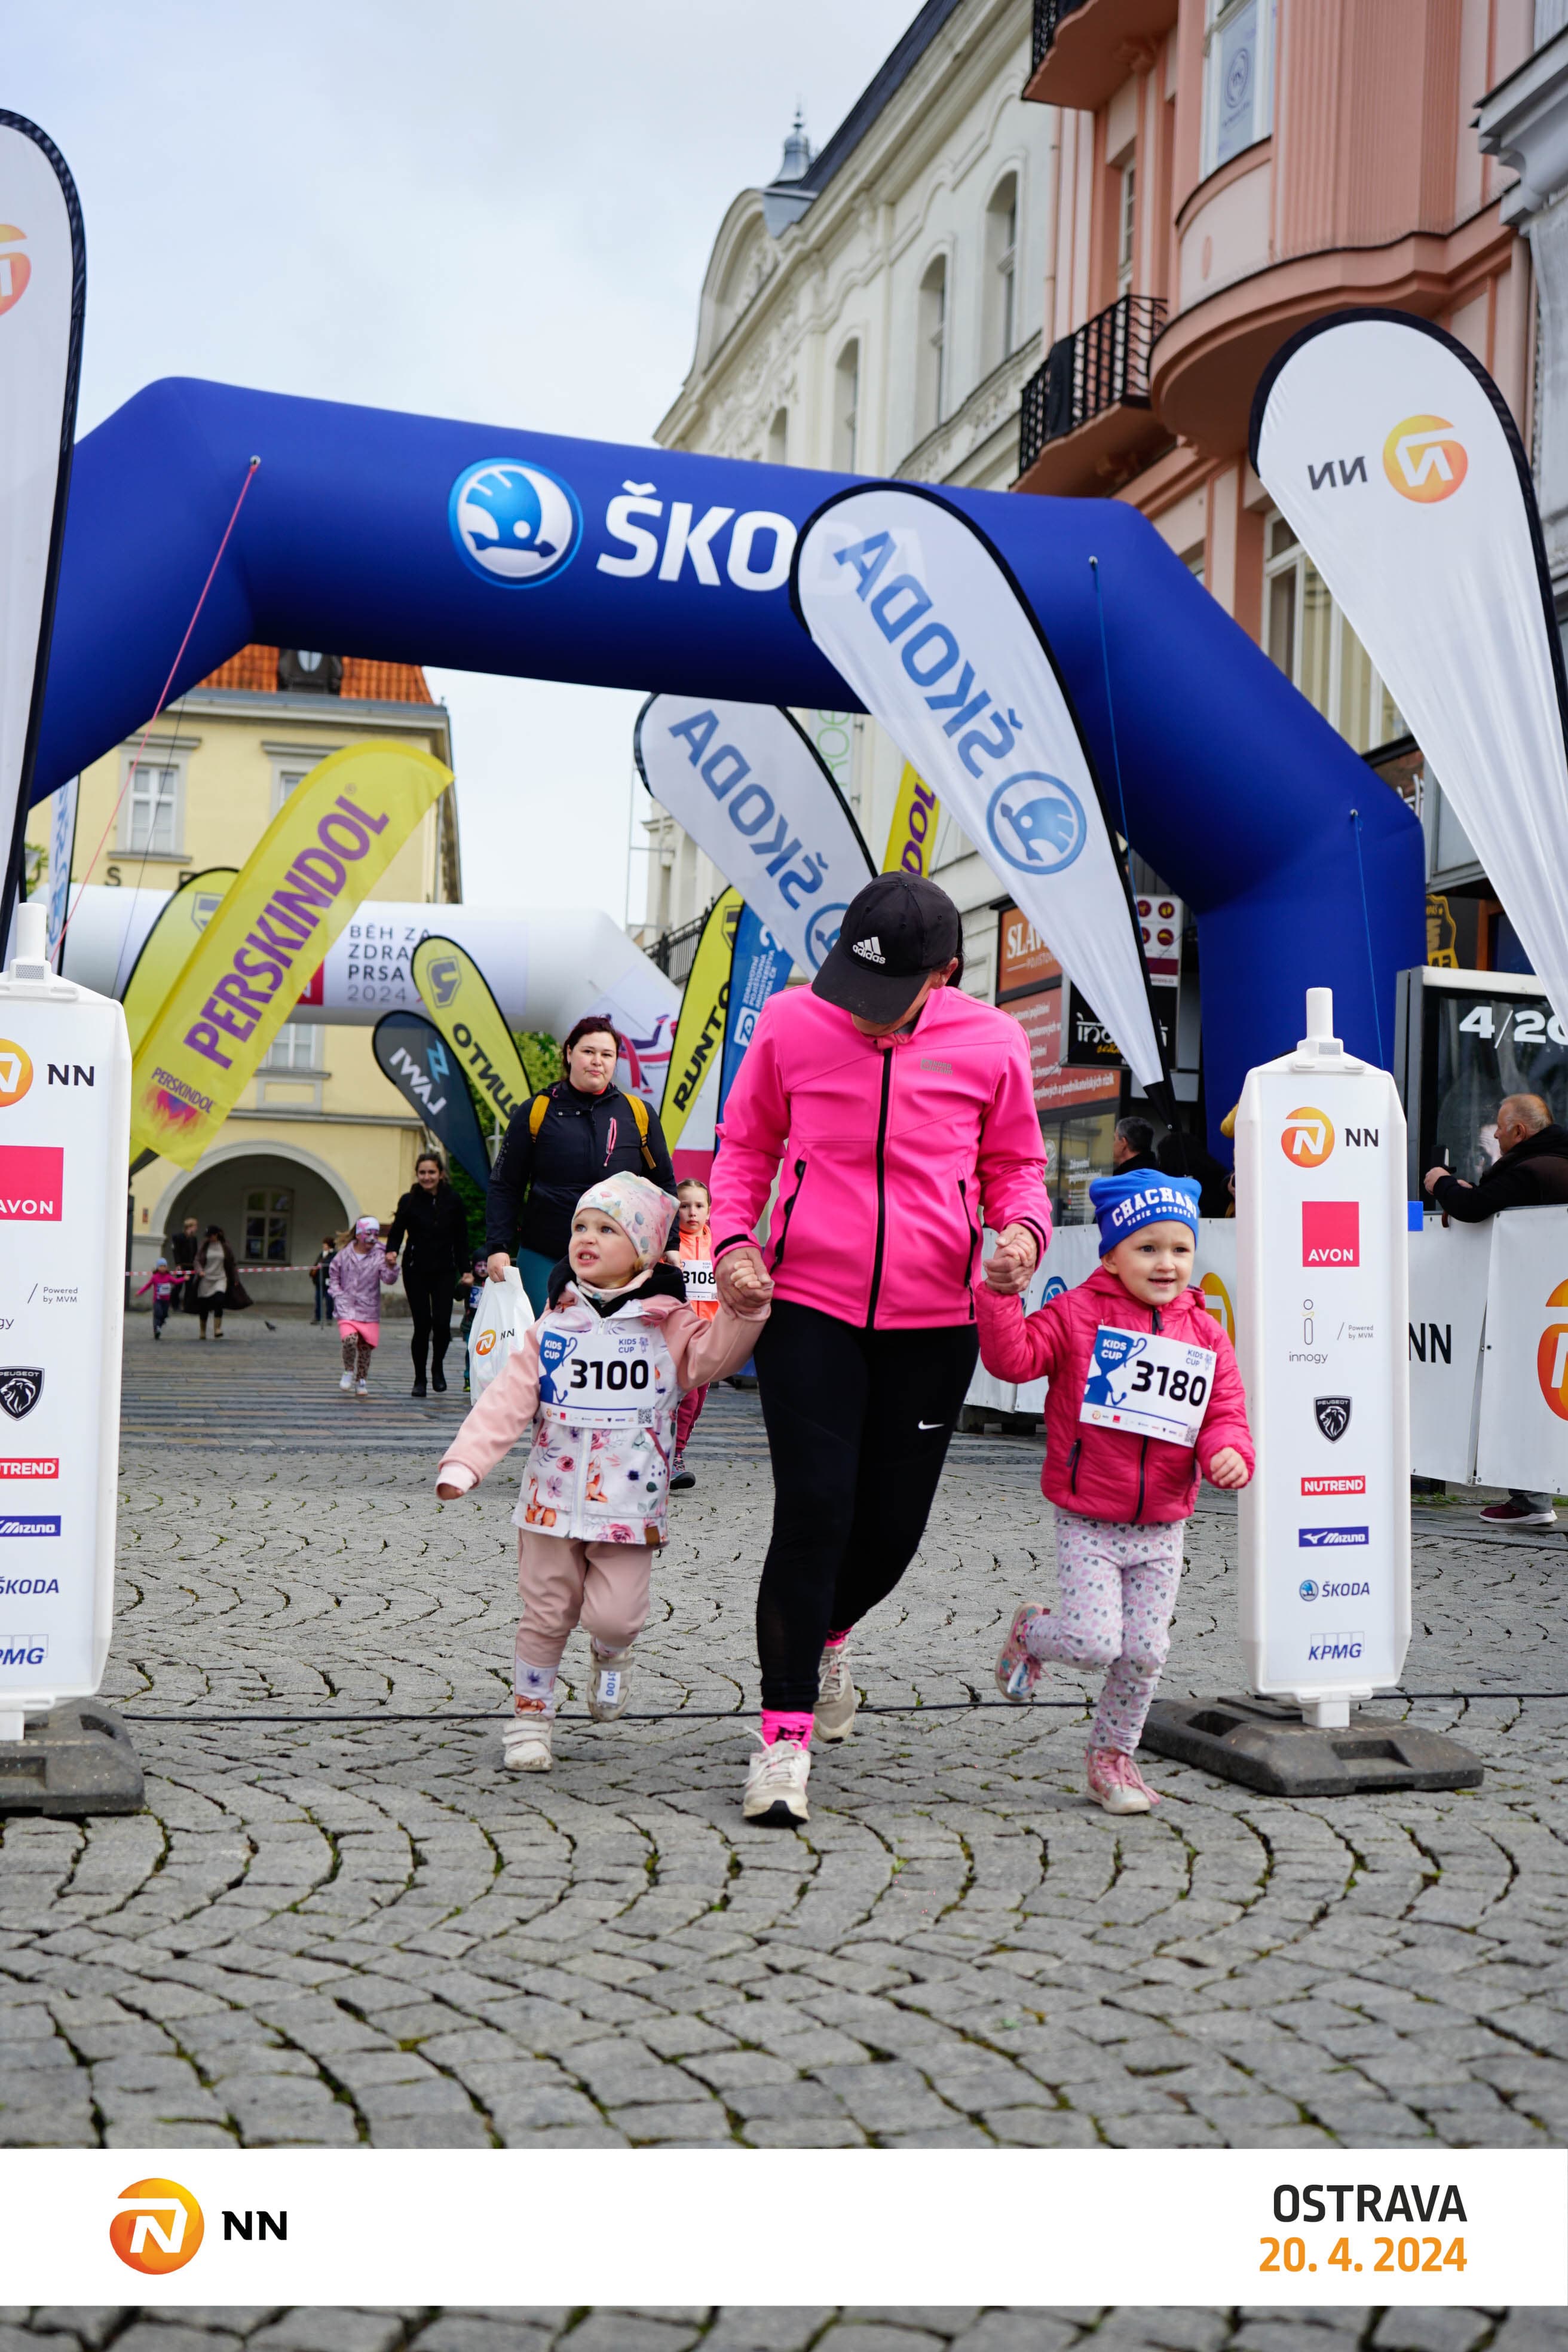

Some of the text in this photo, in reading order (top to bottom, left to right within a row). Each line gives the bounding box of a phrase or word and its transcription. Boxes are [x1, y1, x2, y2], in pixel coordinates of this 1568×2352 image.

[596, 480, 797, 592] ŠKO
[901, 782, 936, 877] DOL
[183, 795, 390, 1070] PERSKINDOL
[350, 924, 430, 942] BĚH ZA
[348, 943, 412, 961] ZDRA
[852, 944, 886, 964] adidas
[348, 964, 405, 982] PRSA
[347, 984, 406, 1002] 2024
[47, 1064, 94, 1086] NN
[151, 1067, 213, 1114] PERSKINDOL
[1345, 1128, 1379, 1147] NN
[1308, 1248, 1353, 1262] AVON
[683, 1270, 716, 1284] 3108
[43, 1296, 53, 1304] by
[500, 1328, 514, 1340] NN
[1408, 1322, 1451, 1364] NN
[544, 1339, 562, 1350] KIDS
[1102, 1339, 1127, 1350] KIDS
[544, 1350, 560, 1359] CUP
[1101, 1349, 1123, 1360] CUP
[1186, 1358, 1200, 1367] CUP
[1187, 1349, 1203, 1359] KIDS
[1289, 1351, 1328, 1364] innogy
[570, 1358, 648, 1390] 3100
[1131, 1360, 1206, 1407] 3180
[1304, 1479, 1364, 1493] NUTREND
[1322, 1581, 1370, 1597] ŠKODA
[1308, 1643, 1362, 1661] KPMG
